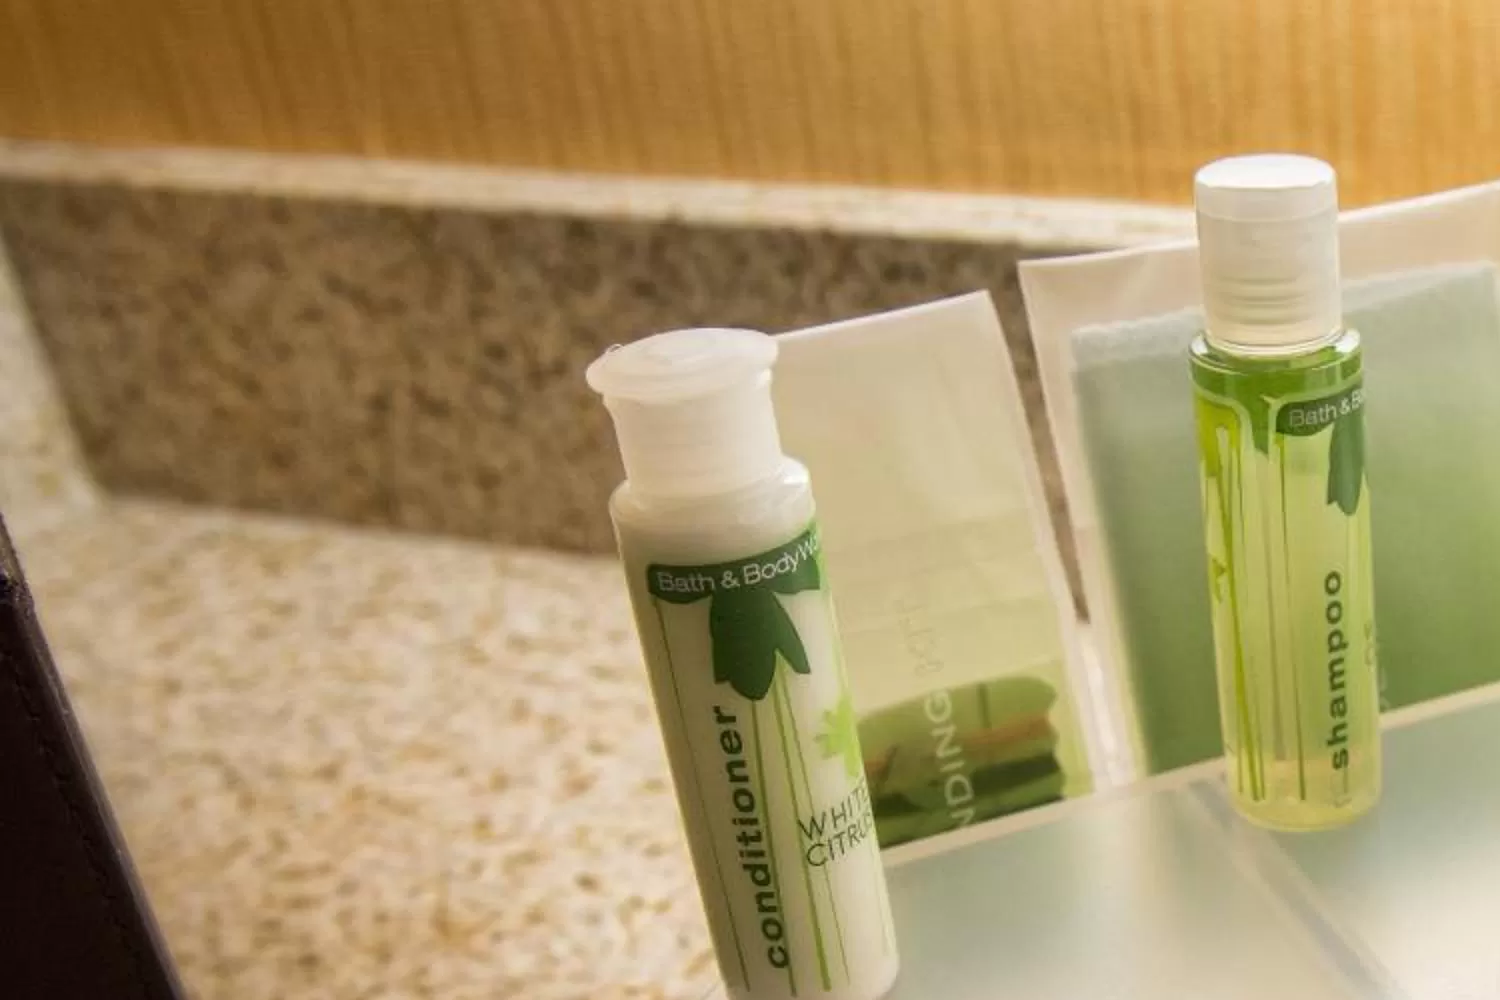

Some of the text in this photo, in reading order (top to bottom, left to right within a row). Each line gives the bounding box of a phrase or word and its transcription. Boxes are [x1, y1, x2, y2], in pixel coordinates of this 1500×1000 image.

[1289, 403, 1337, 427] Bath
[1339, 397, 1351, 415] &
[656, 571, 716, 593] Bath
[720, 570, 740, 589] &
[743, 550, 799, 586] Body
[1324, 571, 1349, 771] shampoo
[714, 706, 789, 968] conditioner
